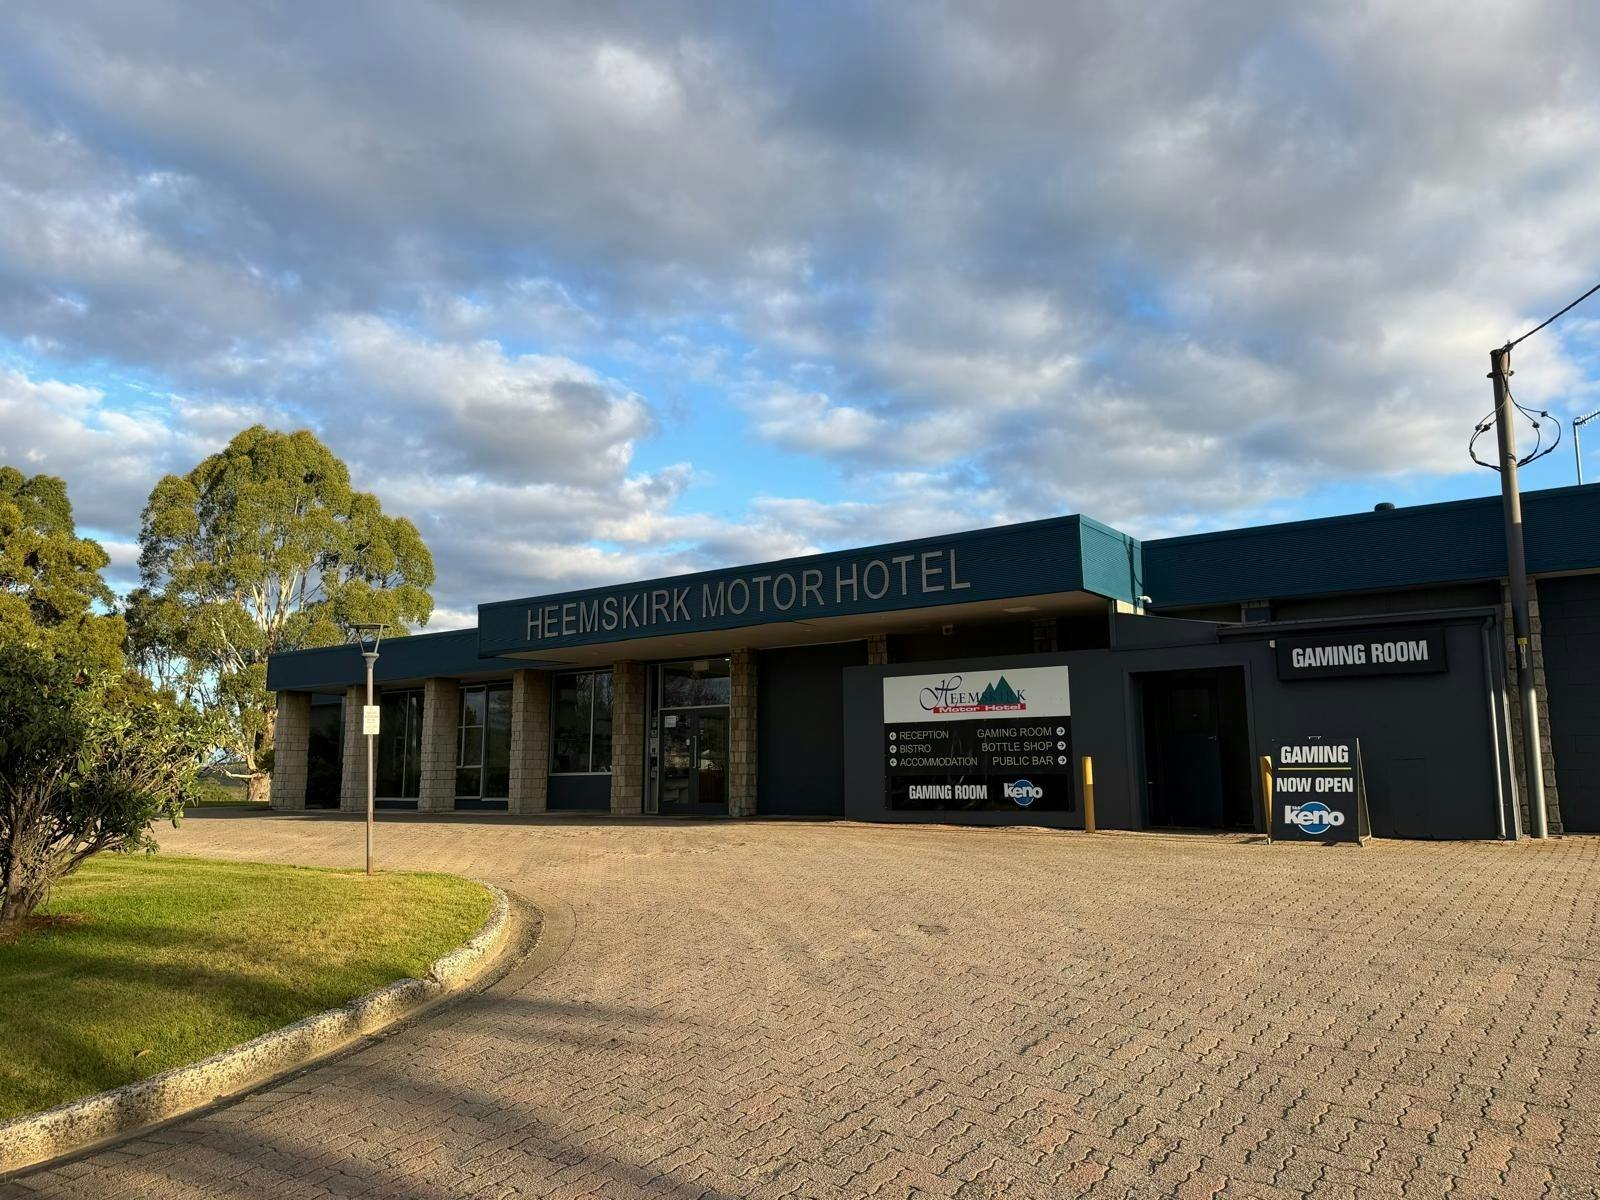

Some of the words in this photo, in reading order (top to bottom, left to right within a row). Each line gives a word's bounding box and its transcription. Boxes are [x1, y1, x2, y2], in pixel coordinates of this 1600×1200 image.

[527, 587, 691, 641] HEEMSKIRK
[701, 569, 825, 618] MOTOR
[837, 548, 971, 603] HOTEL
[1292, 645, 1366, 668] GAMING
[1371, 640, 1429, 664] ROOM
[939, 705, 980, 713] Motor
[984, 703, 1021, 711] Hotel
[899, 730, 949, 740] RECEPTION
[977, 728, 1017, 738] GAMING
[1019, 727, 1052, 737] ROOM
[899, 744, 932, 753] BISTRO
[982, 742, 1020, 752] BOTTLE
[1023, 741, 1053, 751] SHOP
[992, 756, 1030, 766] PUBLIC
[1032, 755, 1054, 765] BAR
[1280, 745, 1349, 764] GAMING
[899, 757, 978, 767] ACCOMMODATION
[1003, 782, 1043, 799] keno
[1276, 778, 1312, 793] NOW
[1315, 777, 1354, 793] OPEN
[909, 785, 952, 800] GAMING
[955, 784, 988, 800] ROOM
[1284, 805, 1345, 826] keno
